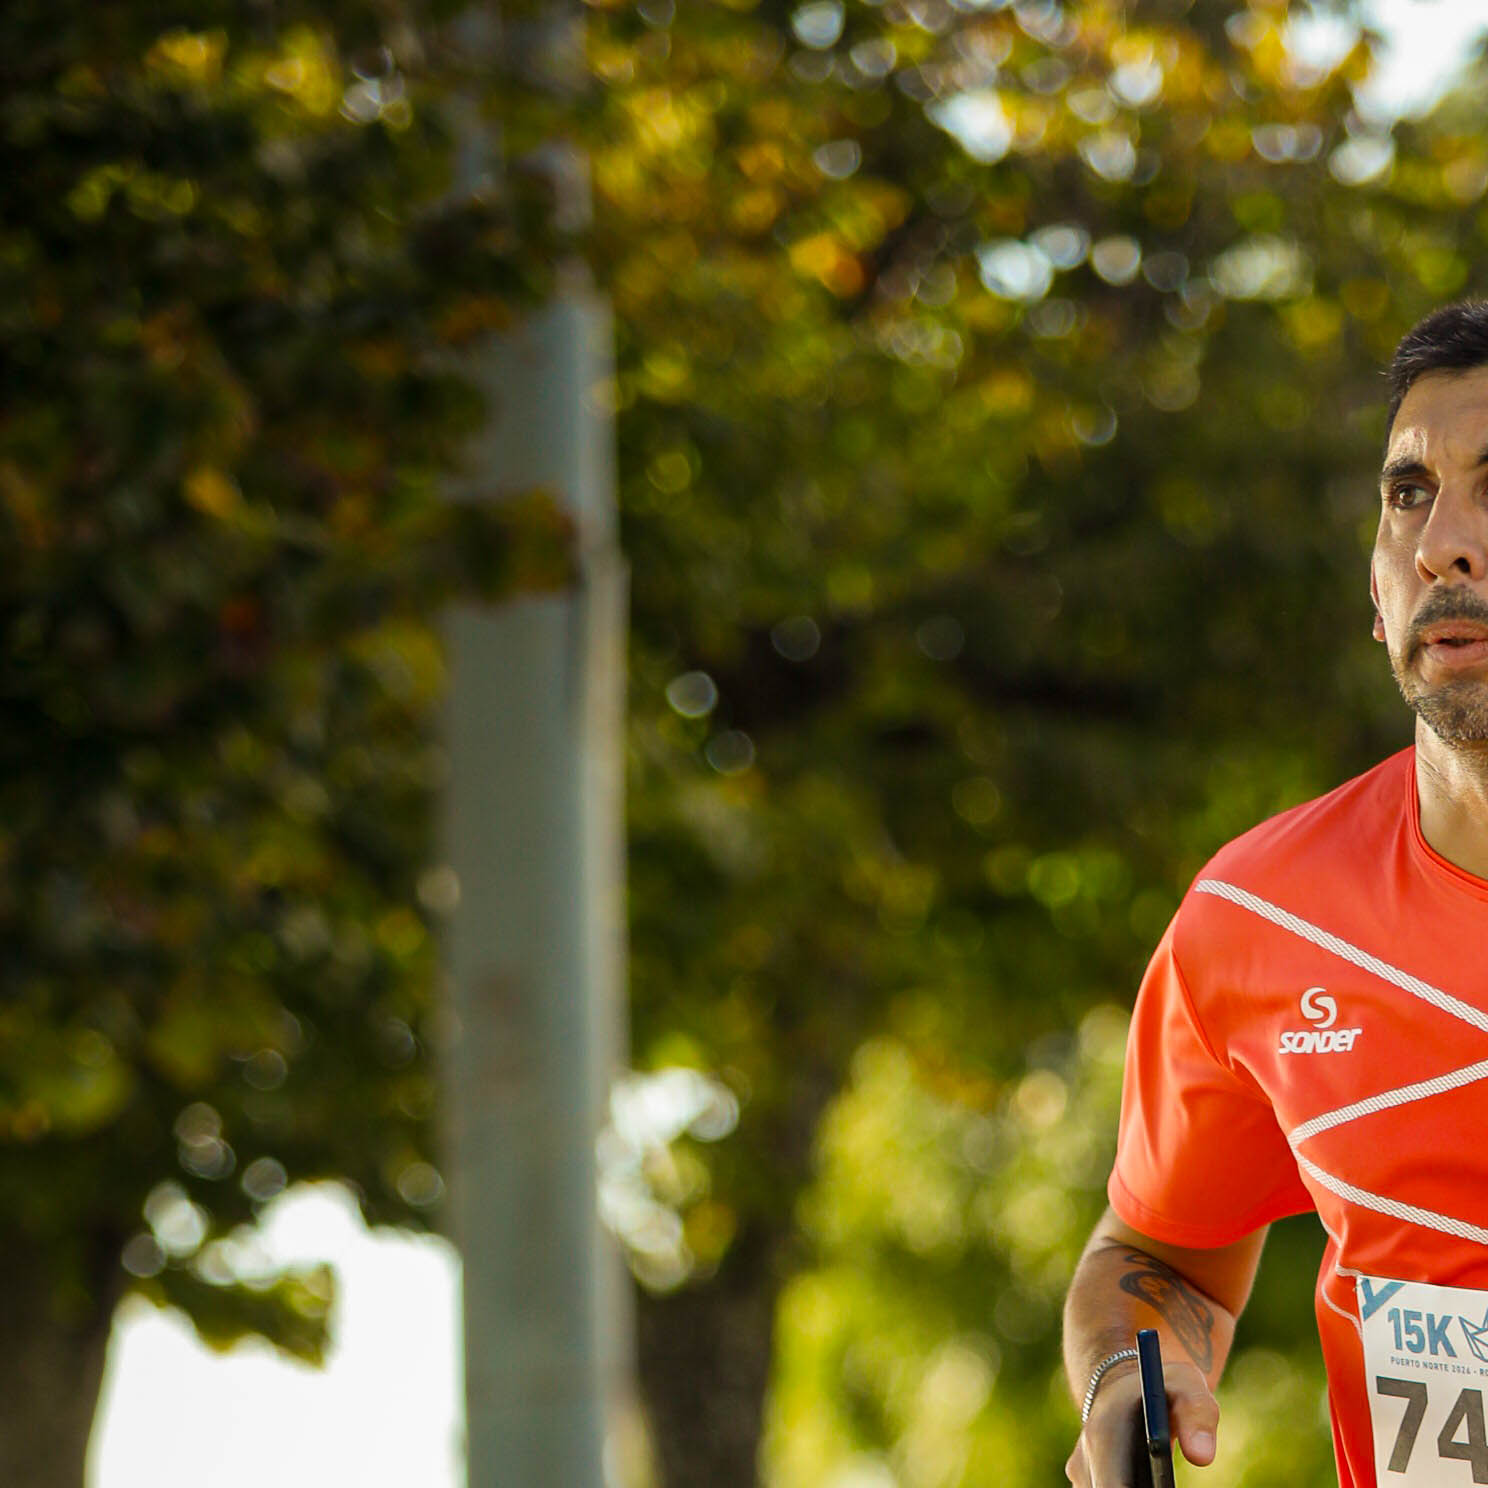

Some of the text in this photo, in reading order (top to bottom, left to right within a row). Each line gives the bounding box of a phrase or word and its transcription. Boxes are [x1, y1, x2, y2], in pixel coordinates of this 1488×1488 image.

[1387, 1307, 1457, 1358] 15K
[1390, 1356, 1420, 1368] PUERTO
[1422, 1361, 1449, 1372] NORTE
